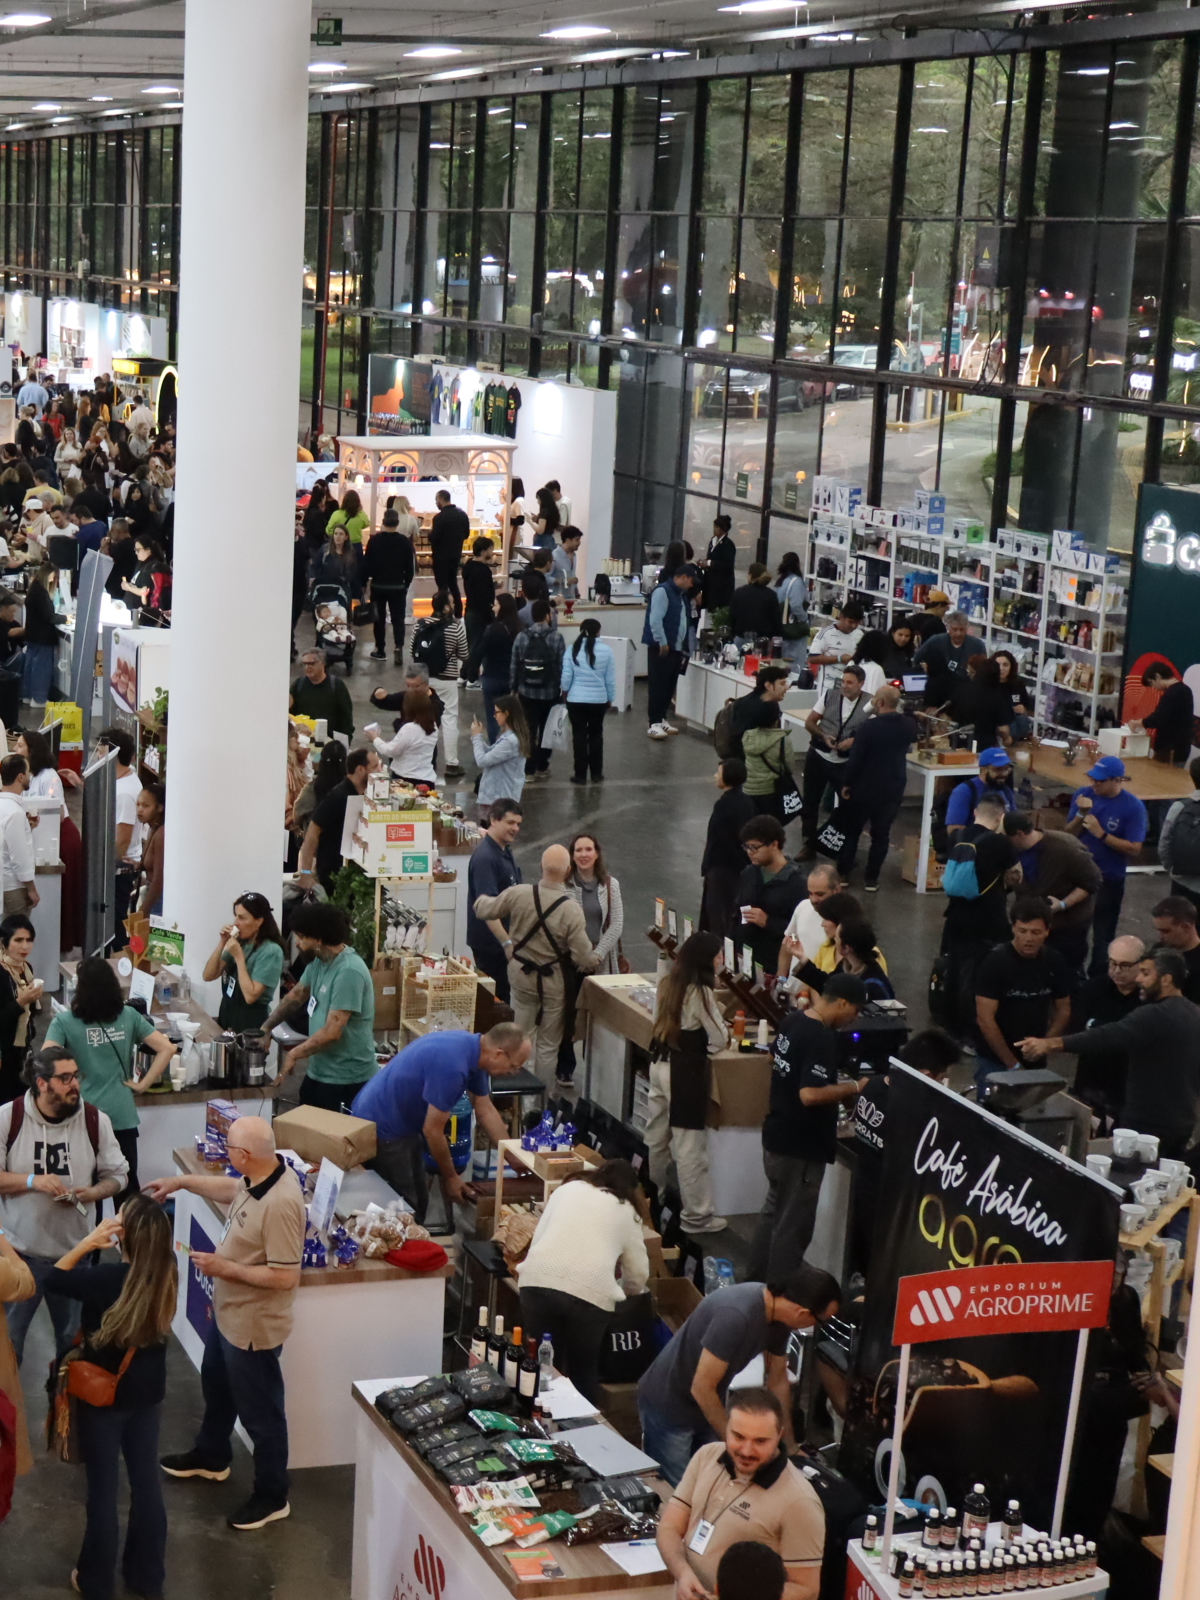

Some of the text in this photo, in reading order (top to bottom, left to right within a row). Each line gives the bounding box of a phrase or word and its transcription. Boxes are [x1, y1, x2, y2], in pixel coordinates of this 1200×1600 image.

[151, 927, 183, 941] Café Verde
[914, 1116, 1068, 1246] Café Arábica
[969, 1281, 1063, 1294] EMPORIUM
[964, 1293, 1094, 1319] AGROPRIME
[610, 1330, 642, 1352] RB
